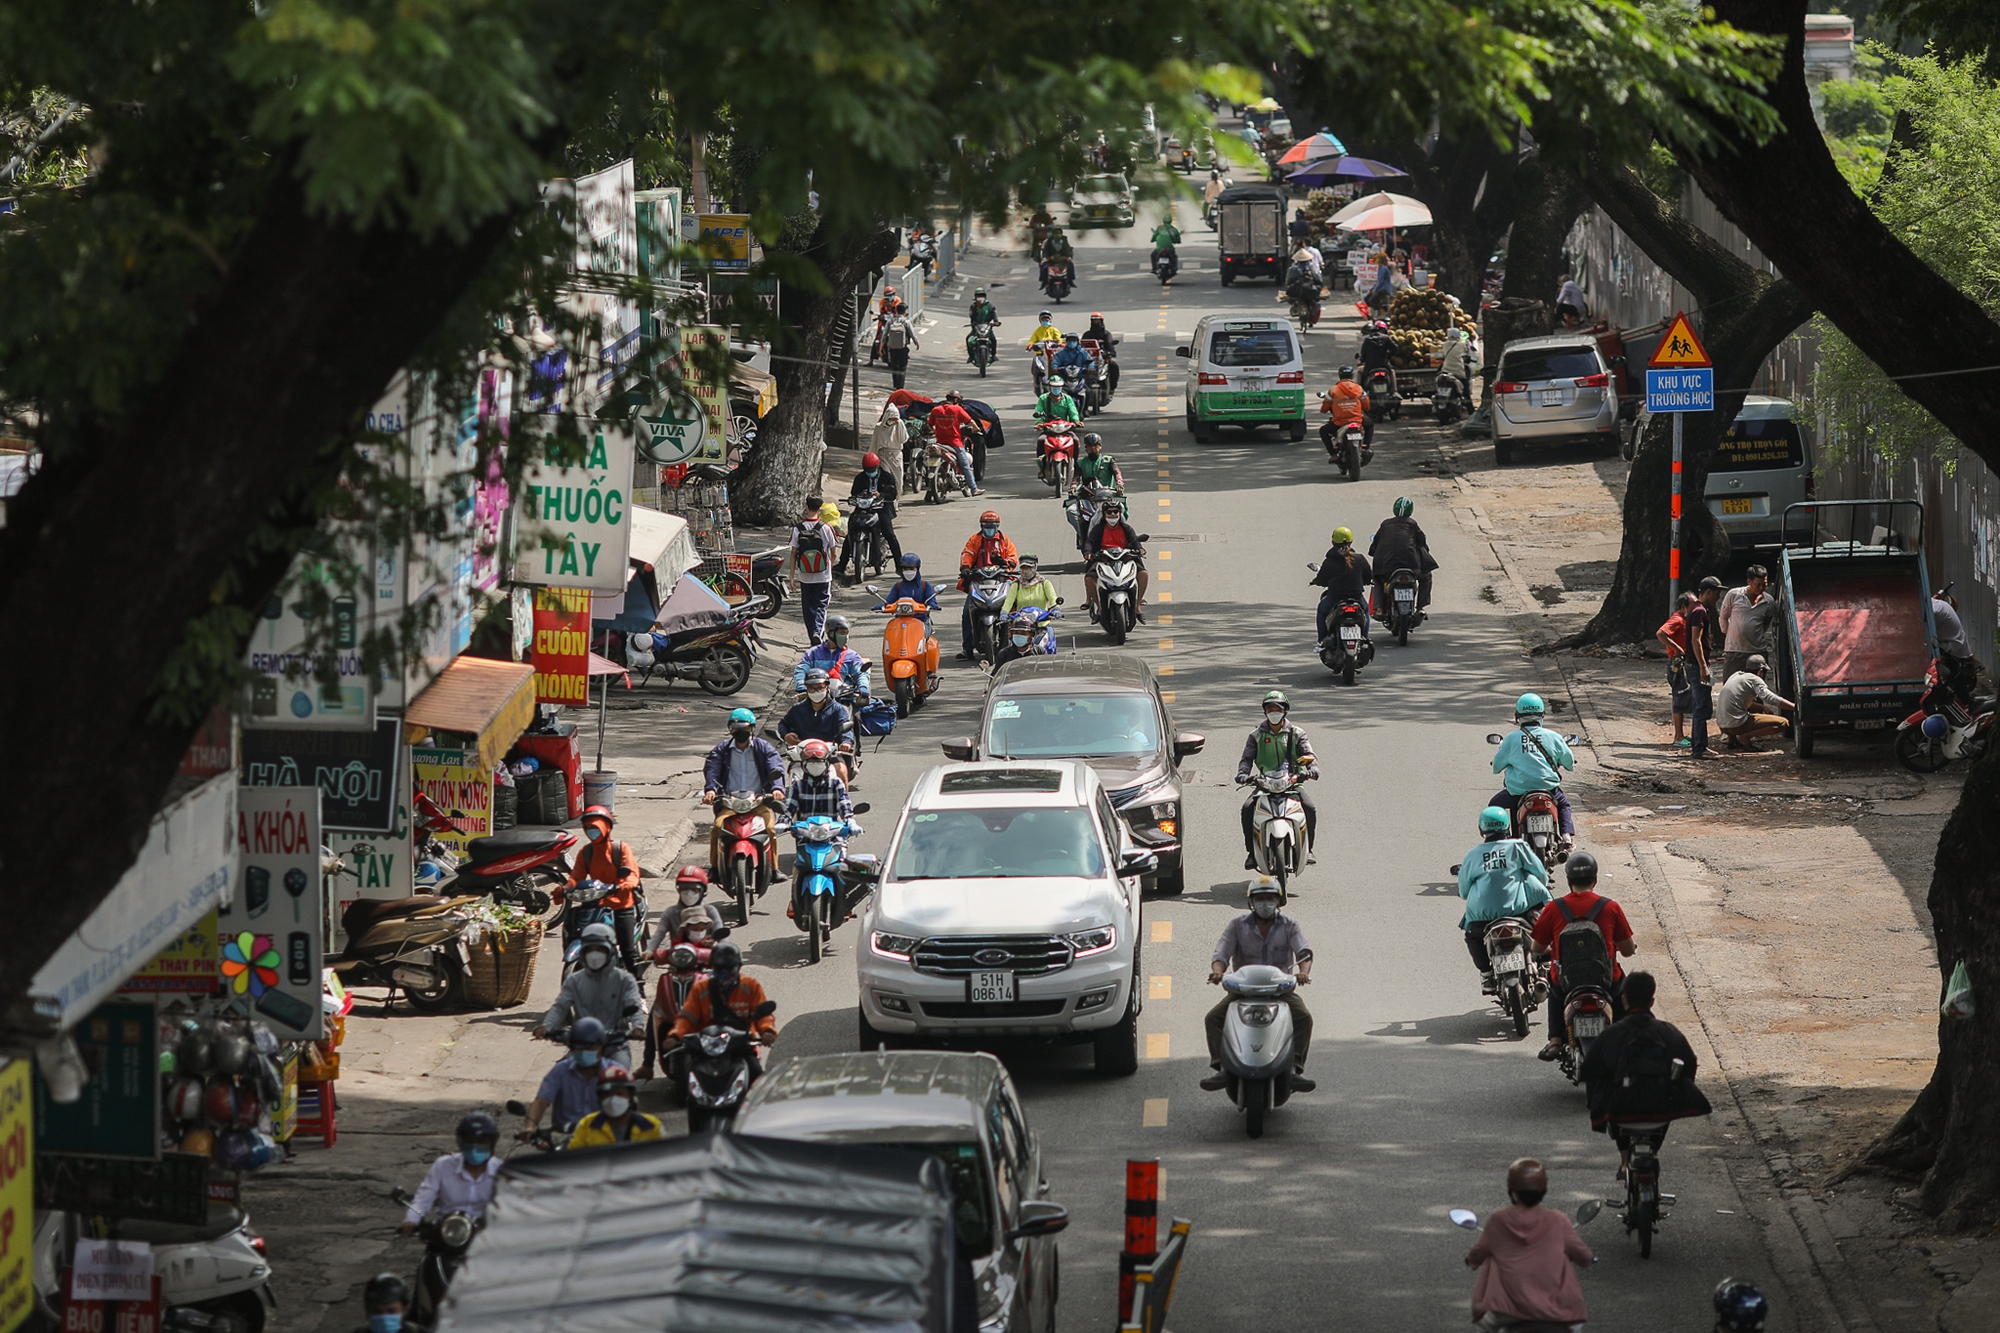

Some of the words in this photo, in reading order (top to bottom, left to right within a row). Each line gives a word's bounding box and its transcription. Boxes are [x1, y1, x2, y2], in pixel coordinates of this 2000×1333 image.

[702, 227, 746, 239] MPE
[1657, 375, 1678, 389] KHU
[1682, 374, 1702, 390] VỰC
[1650, 389, 1690, 406] TRƯỜNG
[1691, 390, 1711, 406] HỌC
[649, 424, 686, 437] VIVA
[527, 475, 623, 525] THUỐC
[541, 531, 602, 577] TÂY
[537, 622, 587, 656] CUỐN
[534, 668, 585, 700] NÓNG
[412, 755, 438, 766] ương
[441, 753, 461, 766] Lan
[250, 756, 300, 787] HÀ
[315, 760, 382, 807] NỘI
[458, 774, 488, 812] NÓNG
[254, 798, 310, 854] KHÓA
[1482, 848, 1506, 862] BAE
[353, 844, 394, 888] TÂY
[1483, 858, 1508, 871] MIN
[159, 959, 190, 973] THAY
[193, 959, 215, 972] PIN
[980, 973, 1004, 987] 51H
[973, 987, 1012, 1001] 086.14
